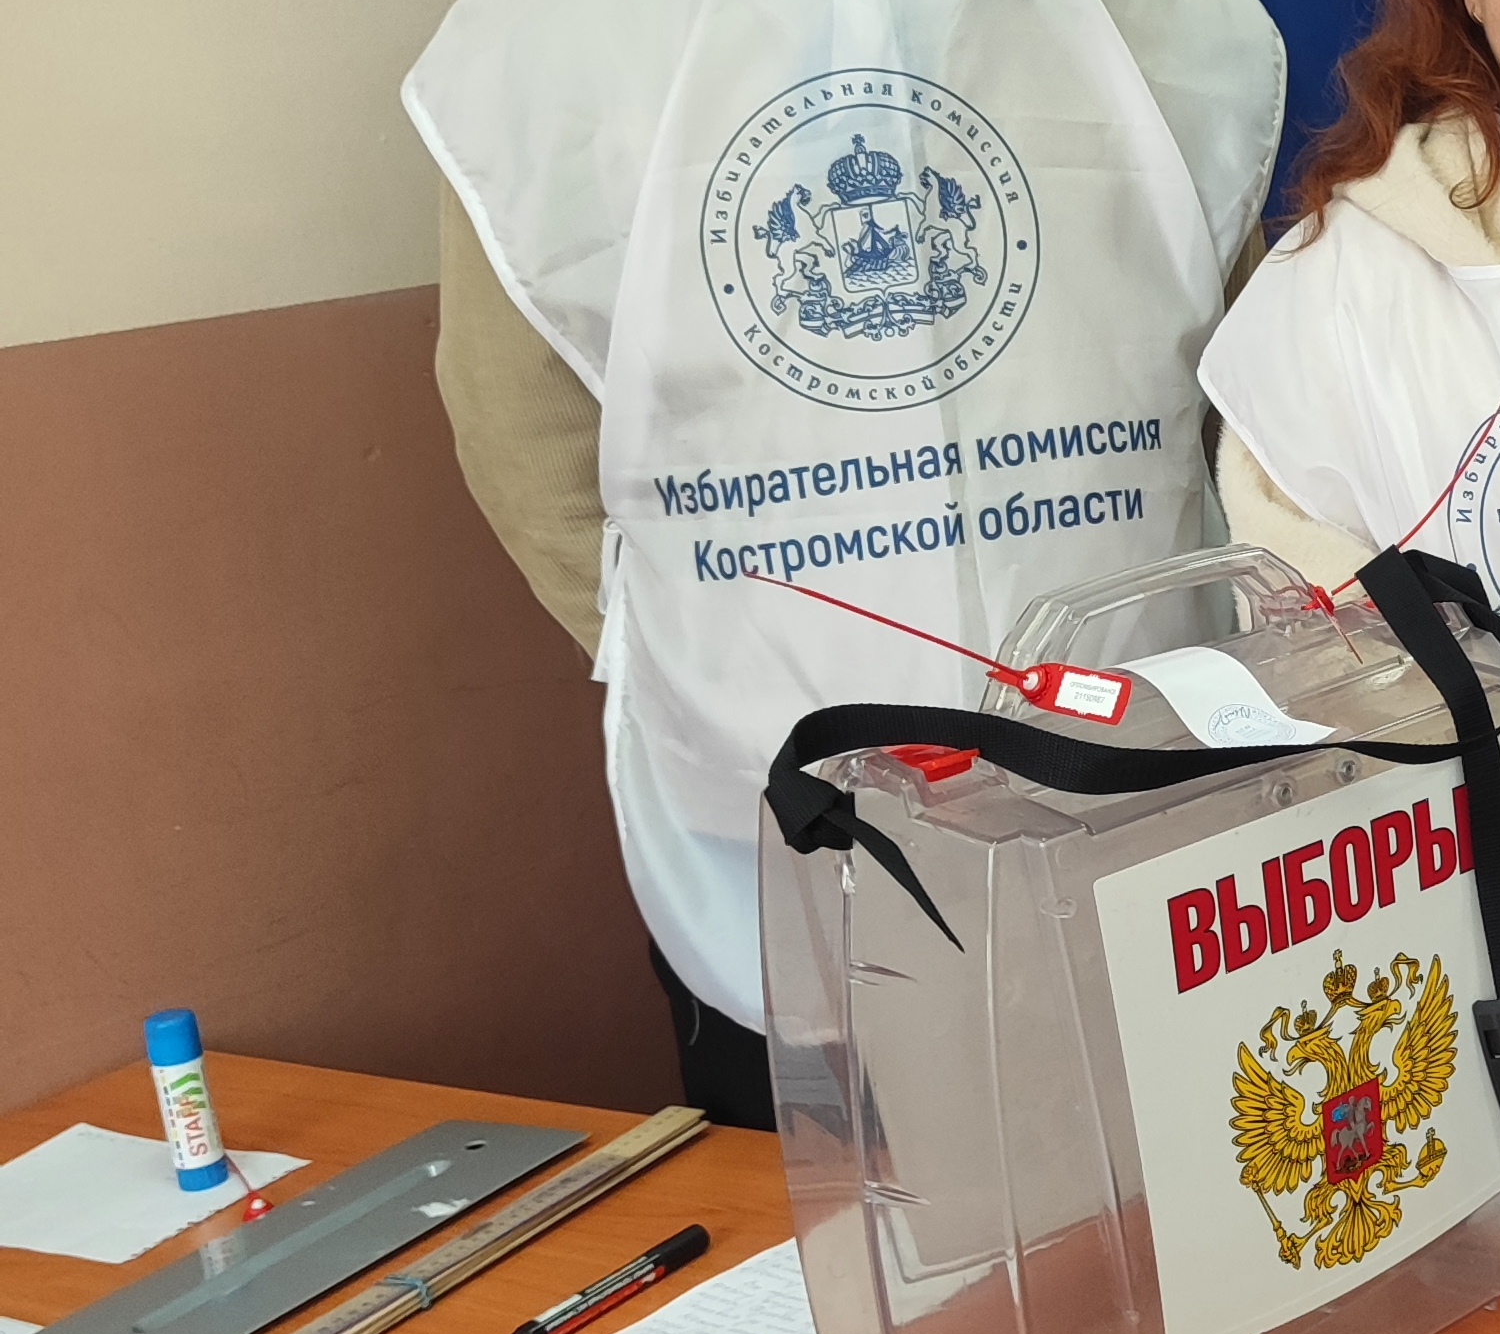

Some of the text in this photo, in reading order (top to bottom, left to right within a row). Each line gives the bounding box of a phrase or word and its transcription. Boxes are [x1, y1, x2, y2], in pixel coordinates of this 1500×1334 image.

[710, 81, 1020, 245] Избирательная комиссия
[743, 281, 1023, 402] Костромской области
[653, 418, 1163, 517] Избирательная комиссия
[694, 487, 1146, 583] Костромской области
[1166, 782, 1476, 996] ВЫБОРЫ
